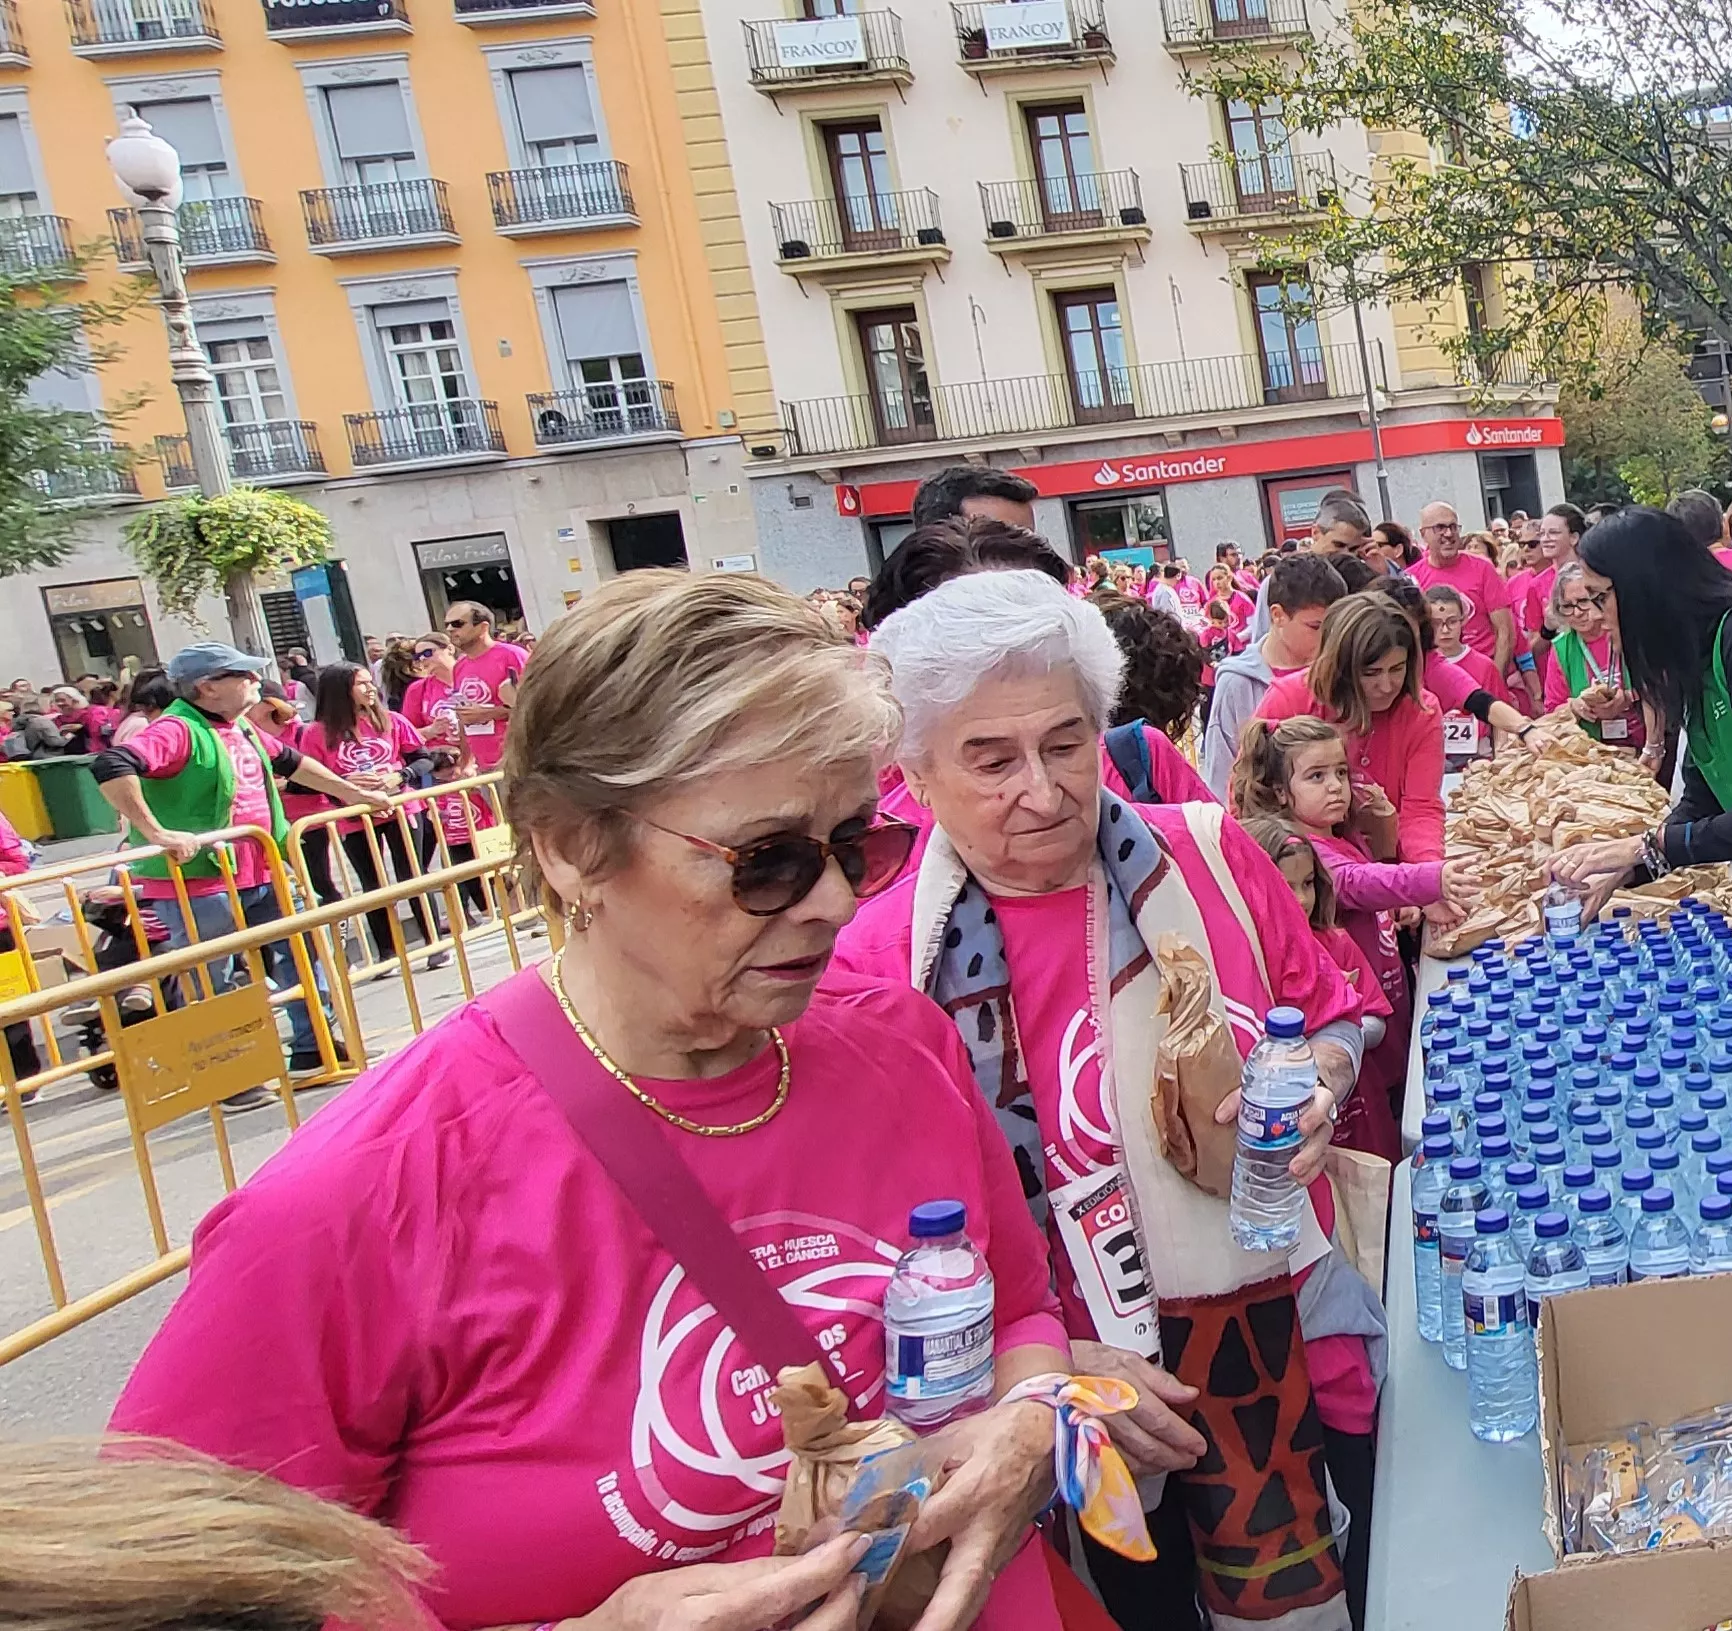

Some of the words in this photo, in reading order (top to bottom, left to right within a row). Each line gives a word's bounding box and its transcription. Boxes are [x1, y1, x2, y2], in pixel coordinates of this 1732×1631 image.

[989, 21, 1065, 42] FRANCOY
[780, 39, 858, 59] FRANCOY
[1483, 426, 1543, 445] Santander
[1122, 456, 1227, 483] Santander
[626, 503, 637, 514] 2
[1444, 724, 1472, 741] 24
[784, 1233, 837, 1251] HUESCA
[768, 1255, 784, 1269] EL
